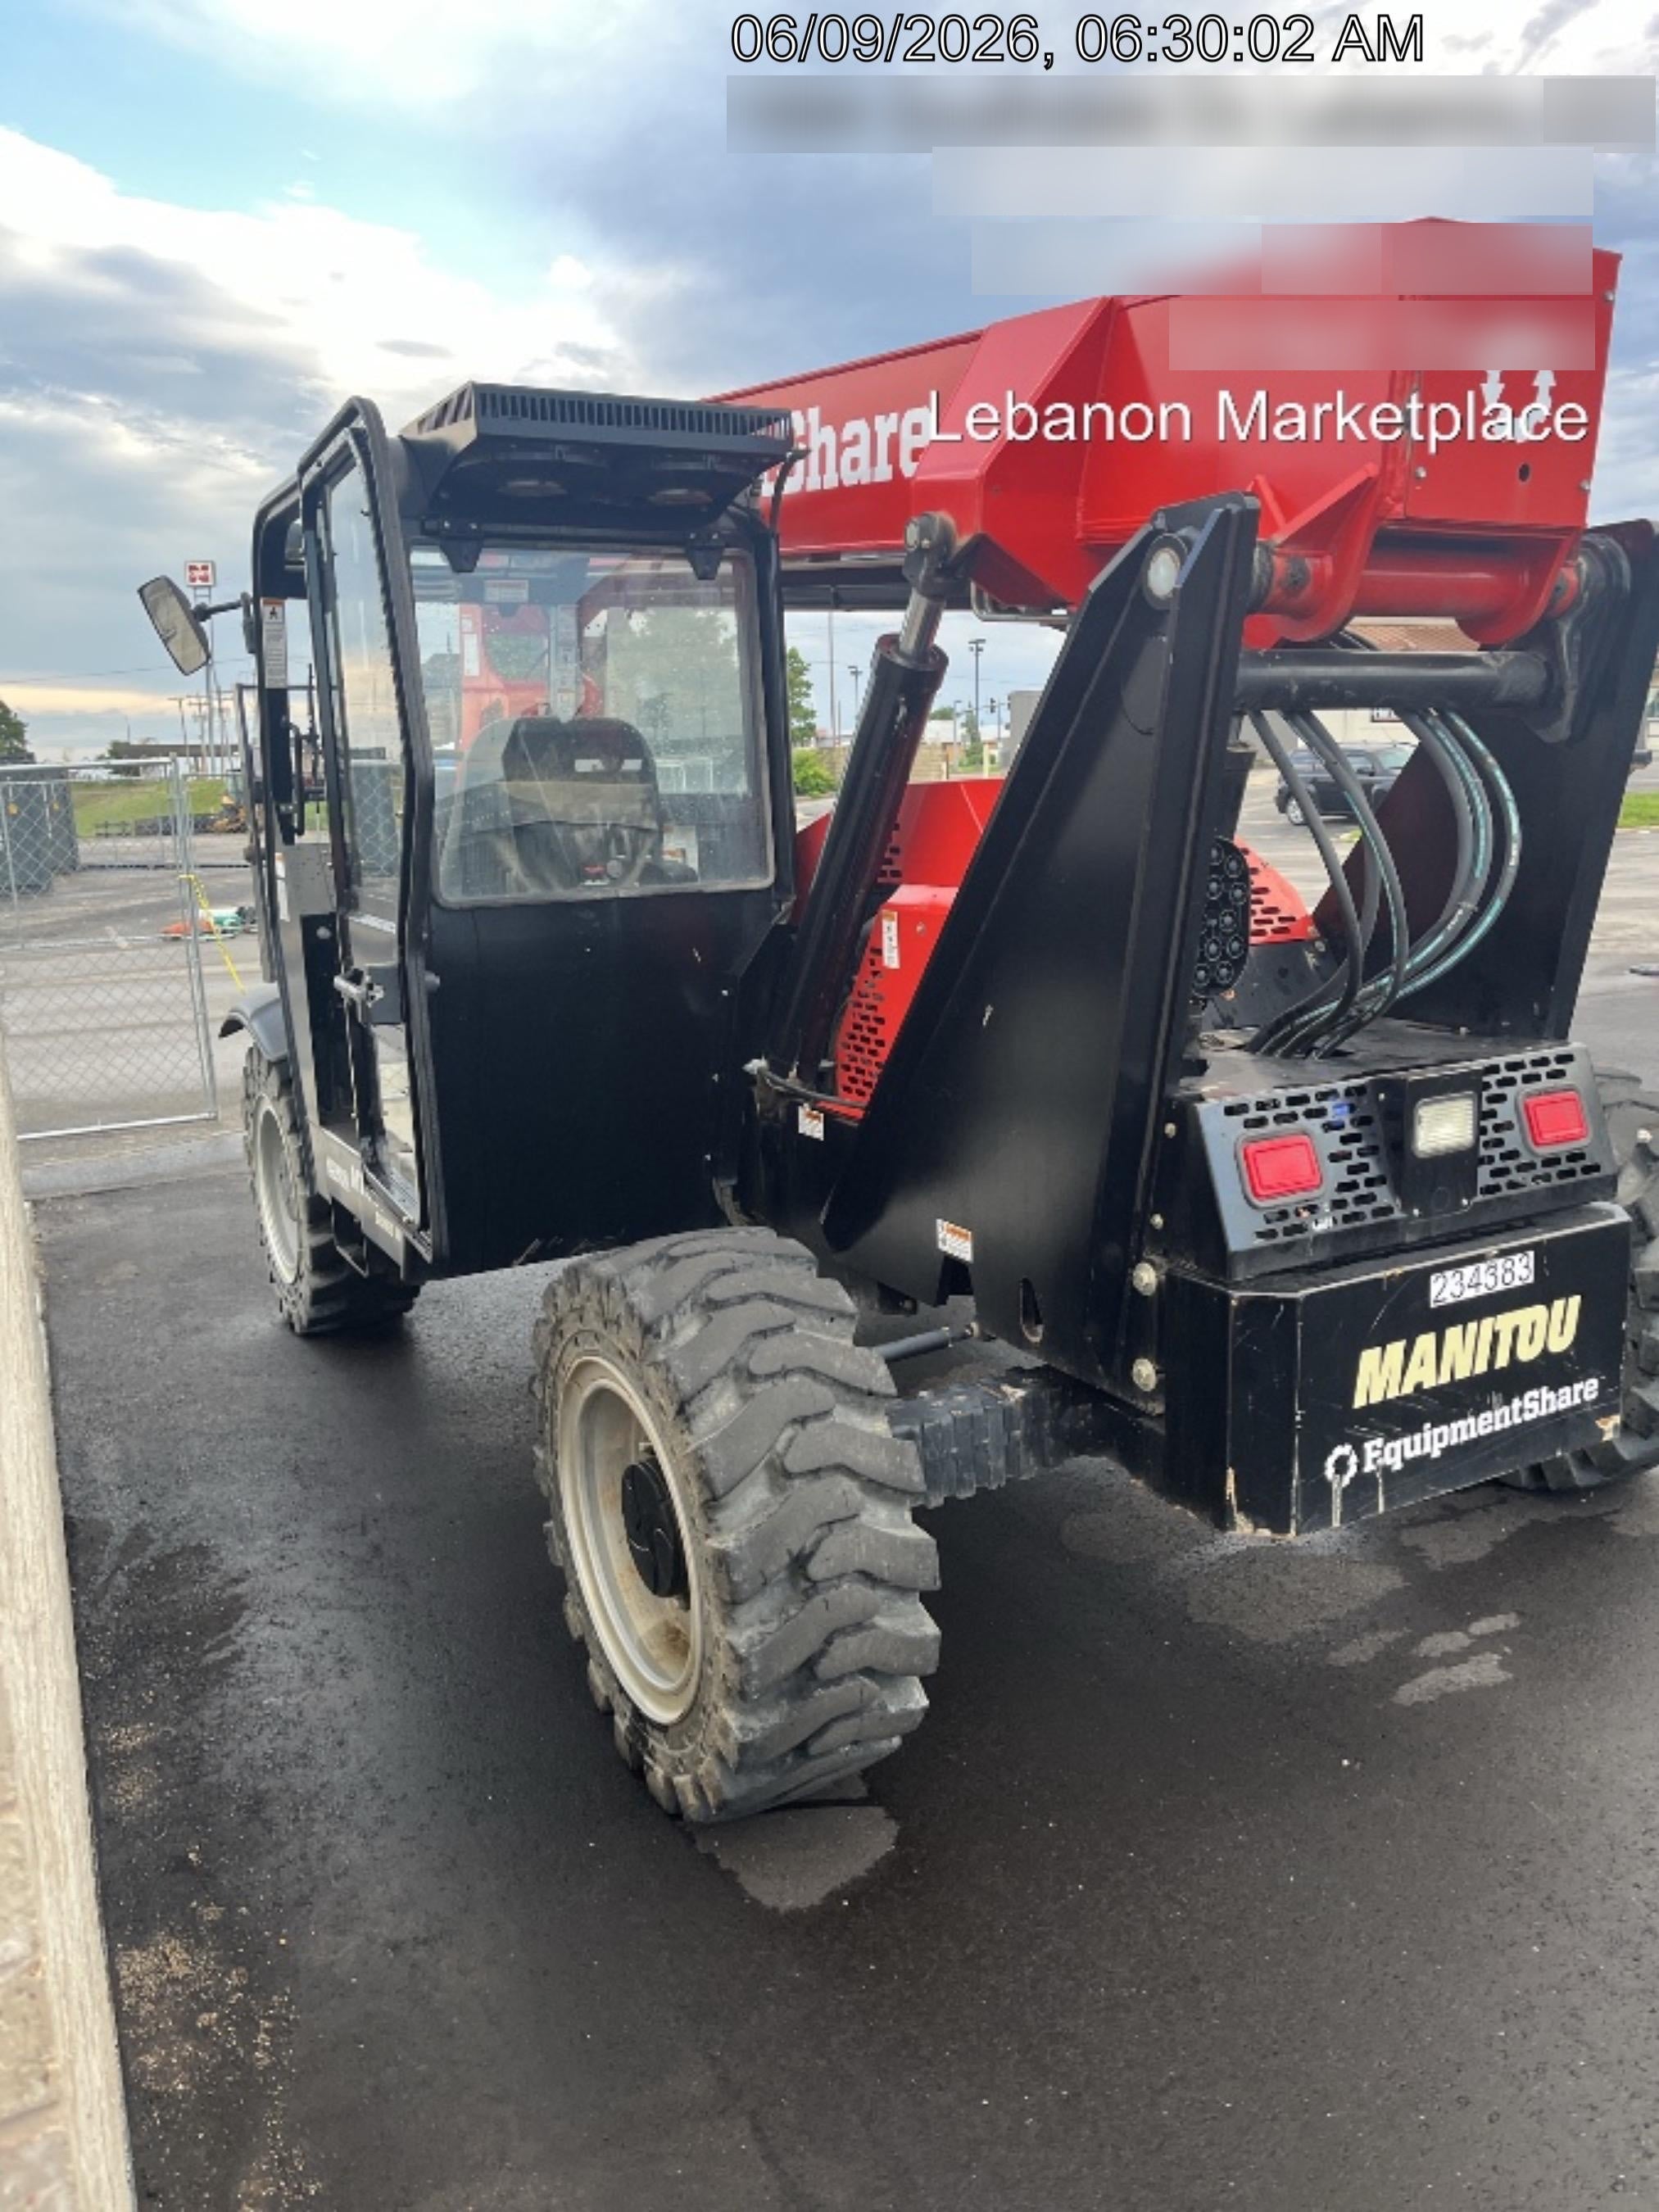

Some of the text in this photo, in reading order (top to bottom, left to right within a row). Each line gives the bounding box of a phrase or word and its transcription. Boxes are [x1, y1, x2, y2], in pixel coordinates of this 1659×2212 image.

[1433, 1252, 1532, 1303] 234383
[1353, 1294, 1582, 1409] MANITOU
[1362, 1377, 1599, 1473] EquipmentShare
